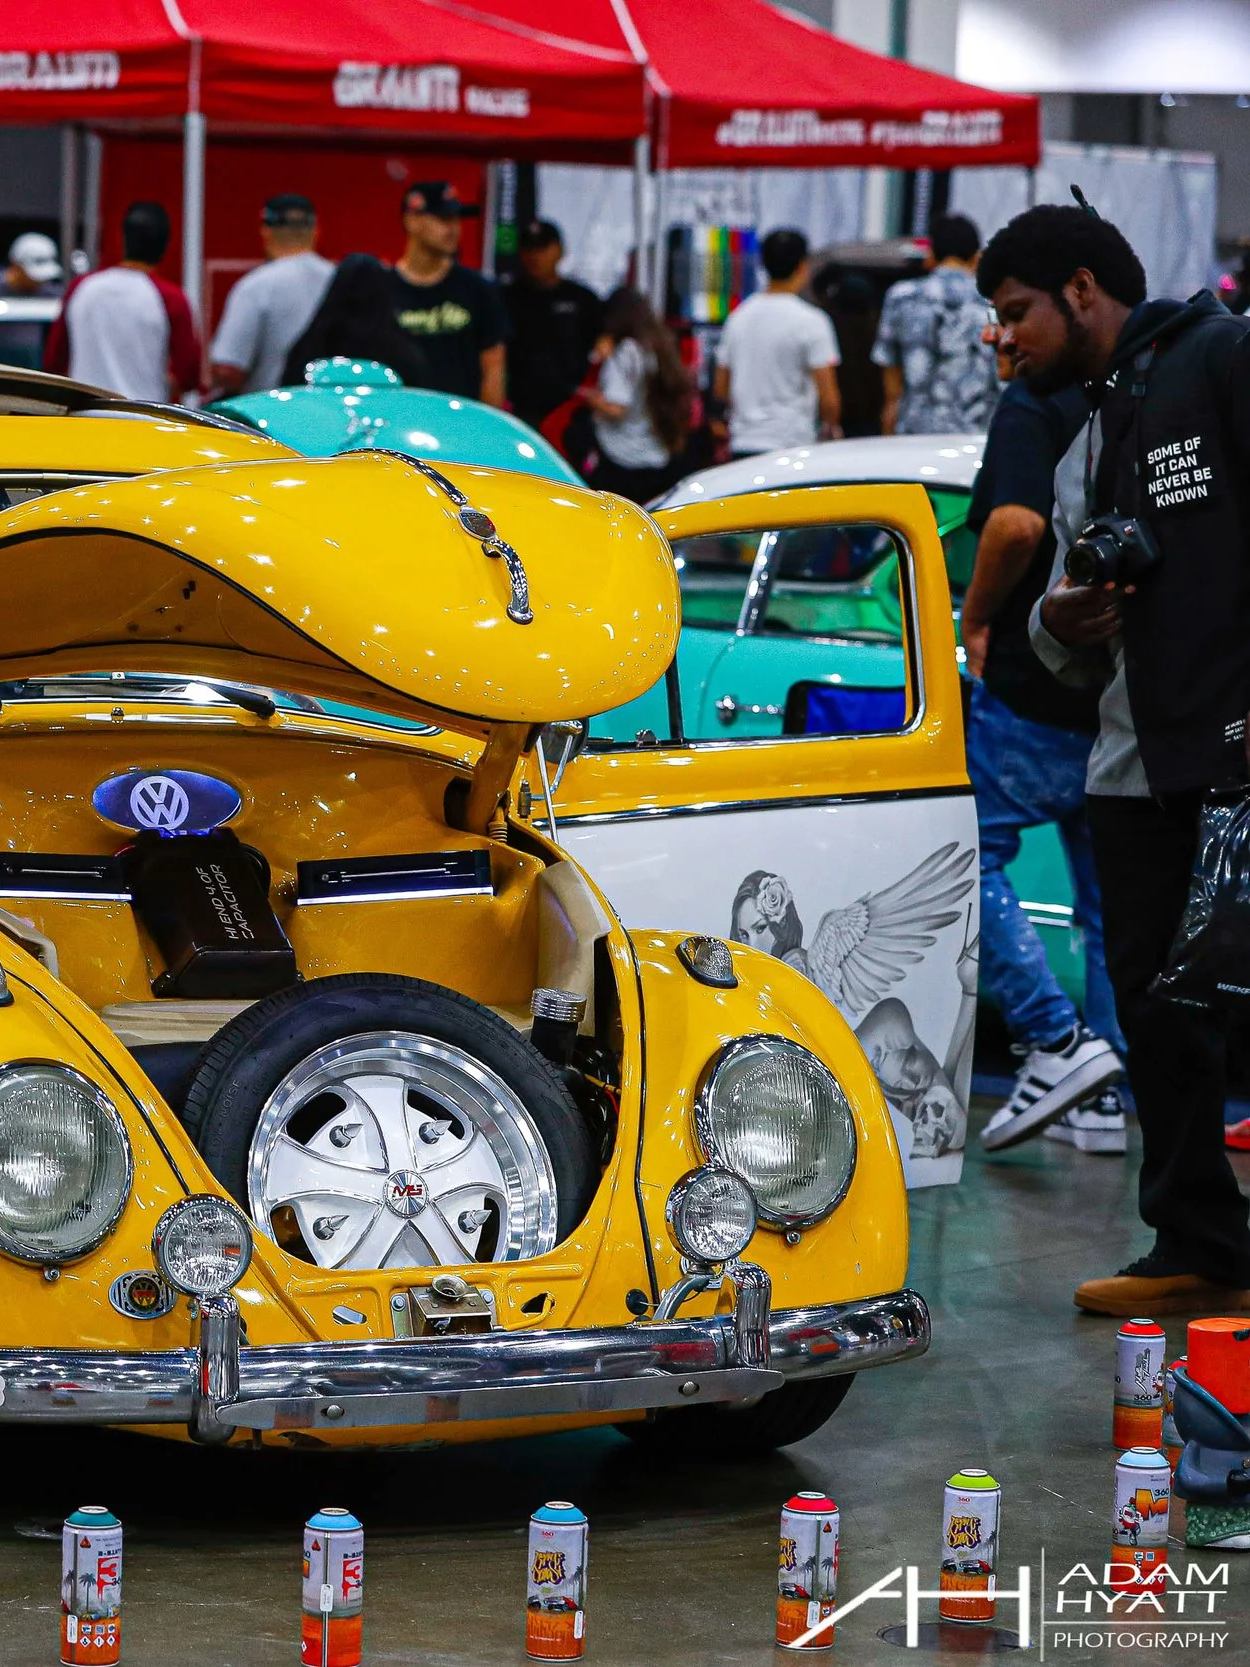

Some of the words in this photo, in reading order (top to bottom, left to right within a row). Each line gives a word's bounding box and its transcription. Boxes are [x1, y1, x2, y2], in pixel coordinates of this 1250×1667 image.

[1147, 443, 1181, 464] SOME
[1184, 436, 1201, 452] OF
[1155, 462, 1166, 477] IT
[1168, 453, 1198, 471] CAN
[1148, 472, 1190, 495] NEVER
[1193, 467, 1212, 482] BE
[1155, 484, 1208, 508] KNOWN
[210, 864, 255, 939] CAPACITOR
[211, 897, 232, 924] END
[224, 926, 239, 939] HI
